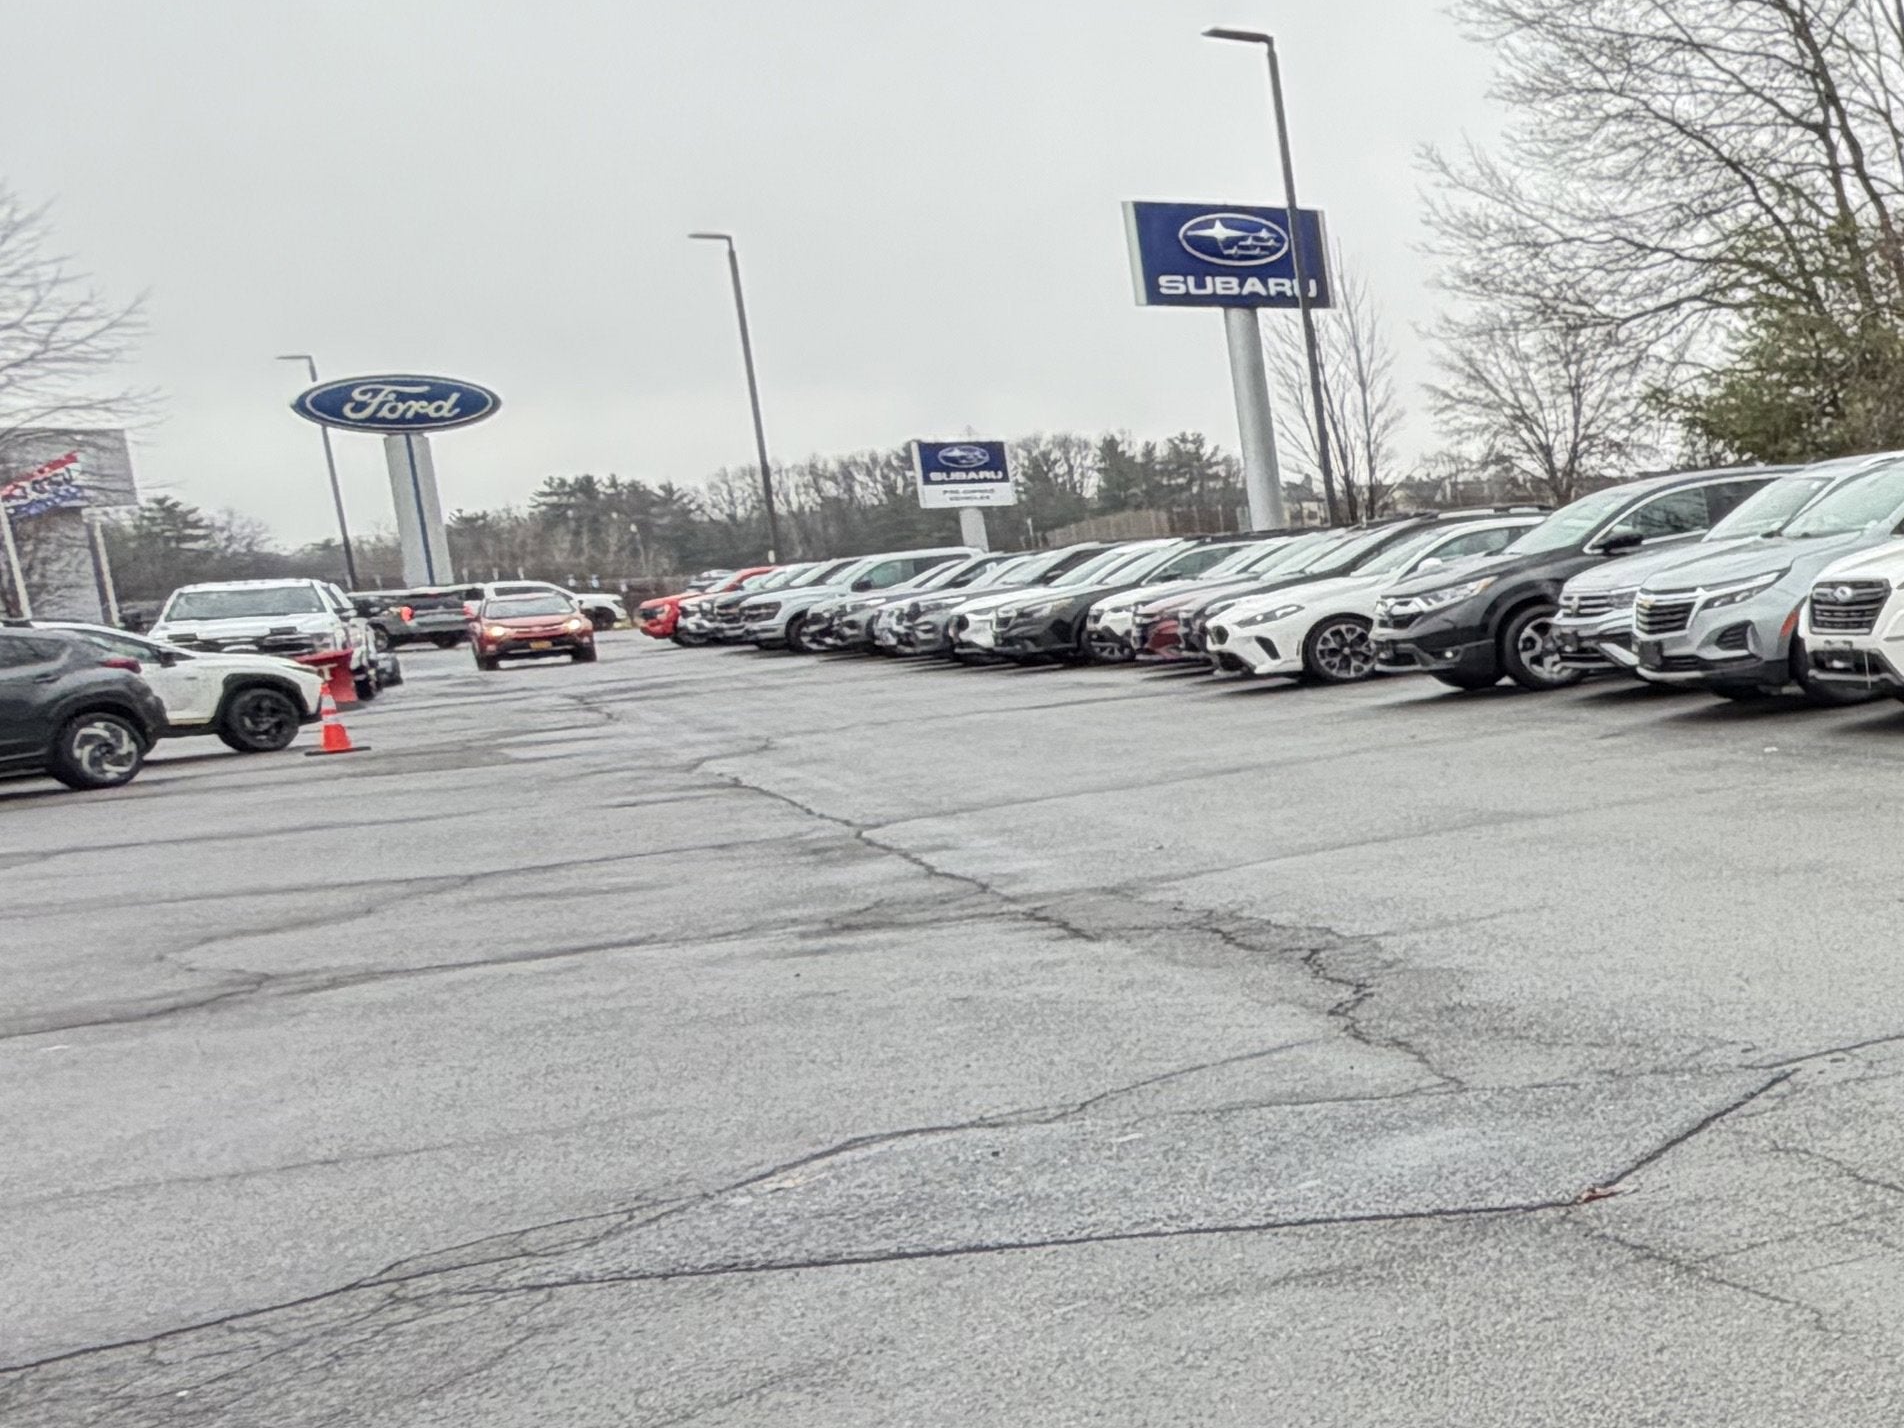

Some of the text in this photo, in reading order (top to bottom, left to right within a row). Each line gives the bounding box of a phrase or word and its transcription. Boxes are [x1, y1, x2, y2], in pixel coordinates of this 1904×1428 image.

[1158, 275, 1317, 298] SUBARU
[342, 384, 461, 420] Ford
[929, 470, 1003, 481] SUBARU
